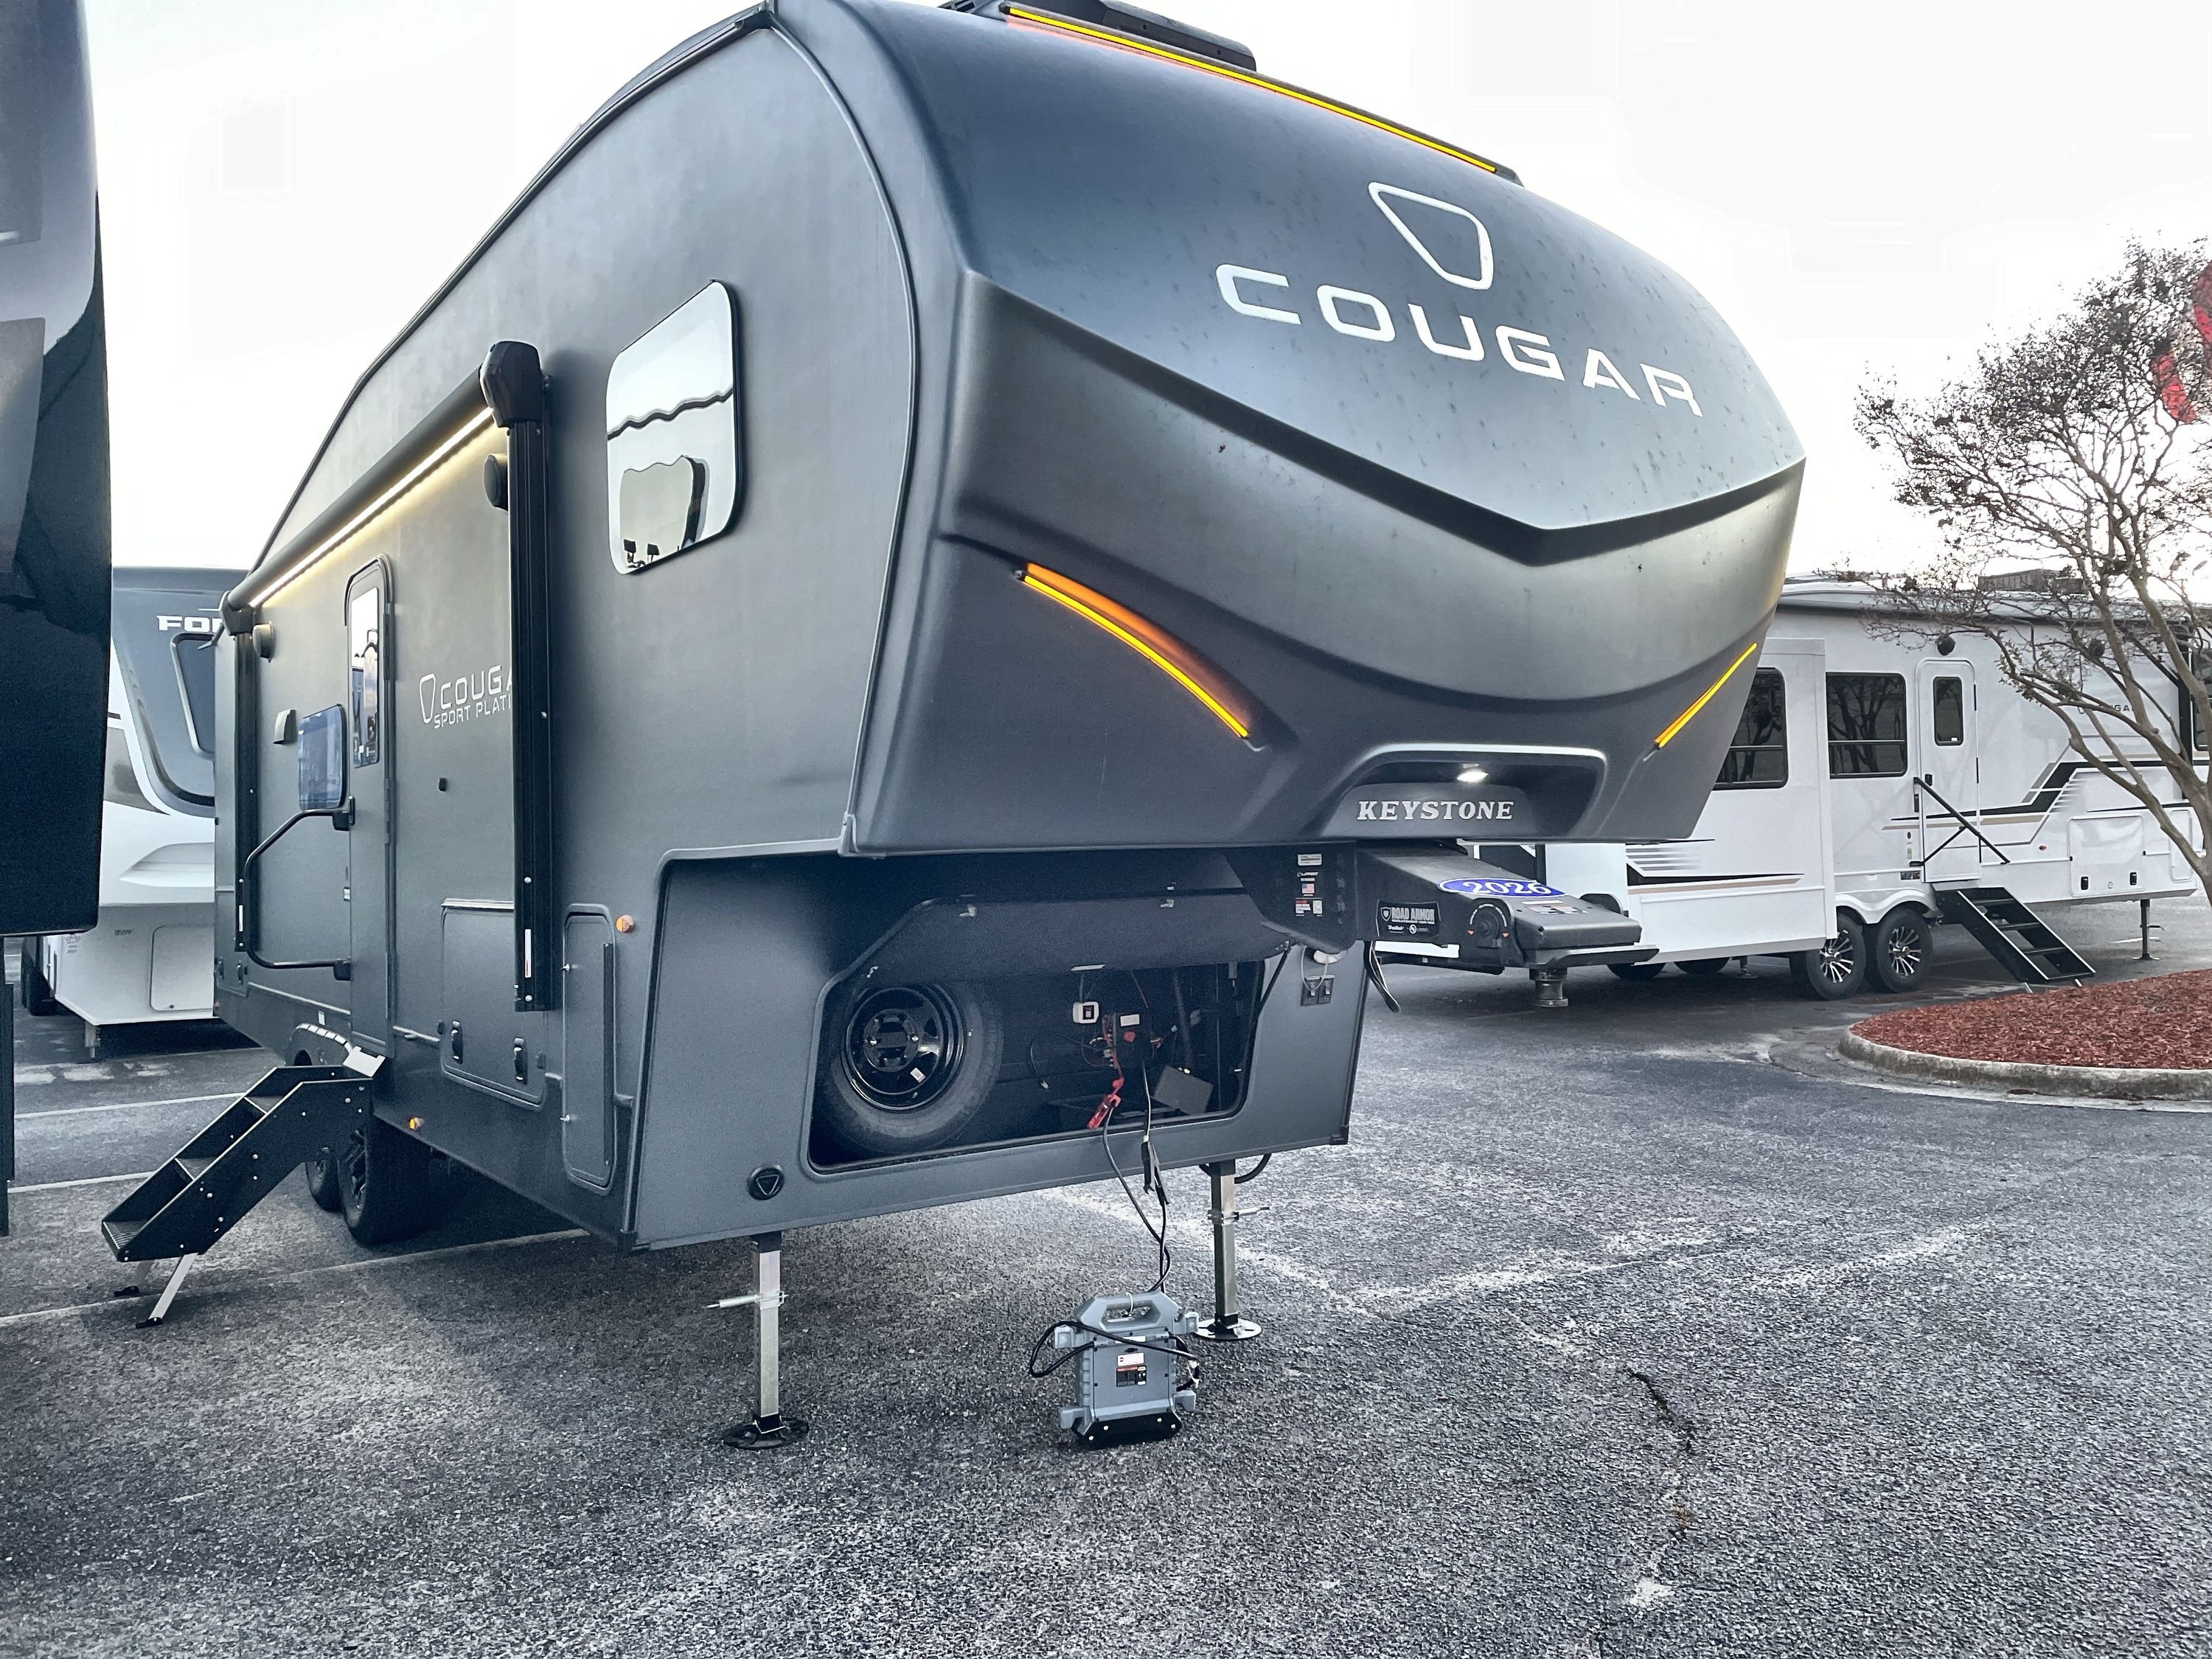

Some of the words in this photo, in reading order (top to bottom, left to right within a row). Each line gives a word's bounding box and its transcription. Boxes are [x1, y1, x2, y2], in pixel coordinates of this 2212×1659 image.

[1215, 263, 1704, 417] COUGAR
[434, 705, 471, 729] SPORT
[1357, 800, 1514, 821] KEYSTONE
[1462, 881, 1552, 894] 2026
[1391, 907, 1409, 920] ROAD
[1411, 908, 1435, 922] ARMOR
